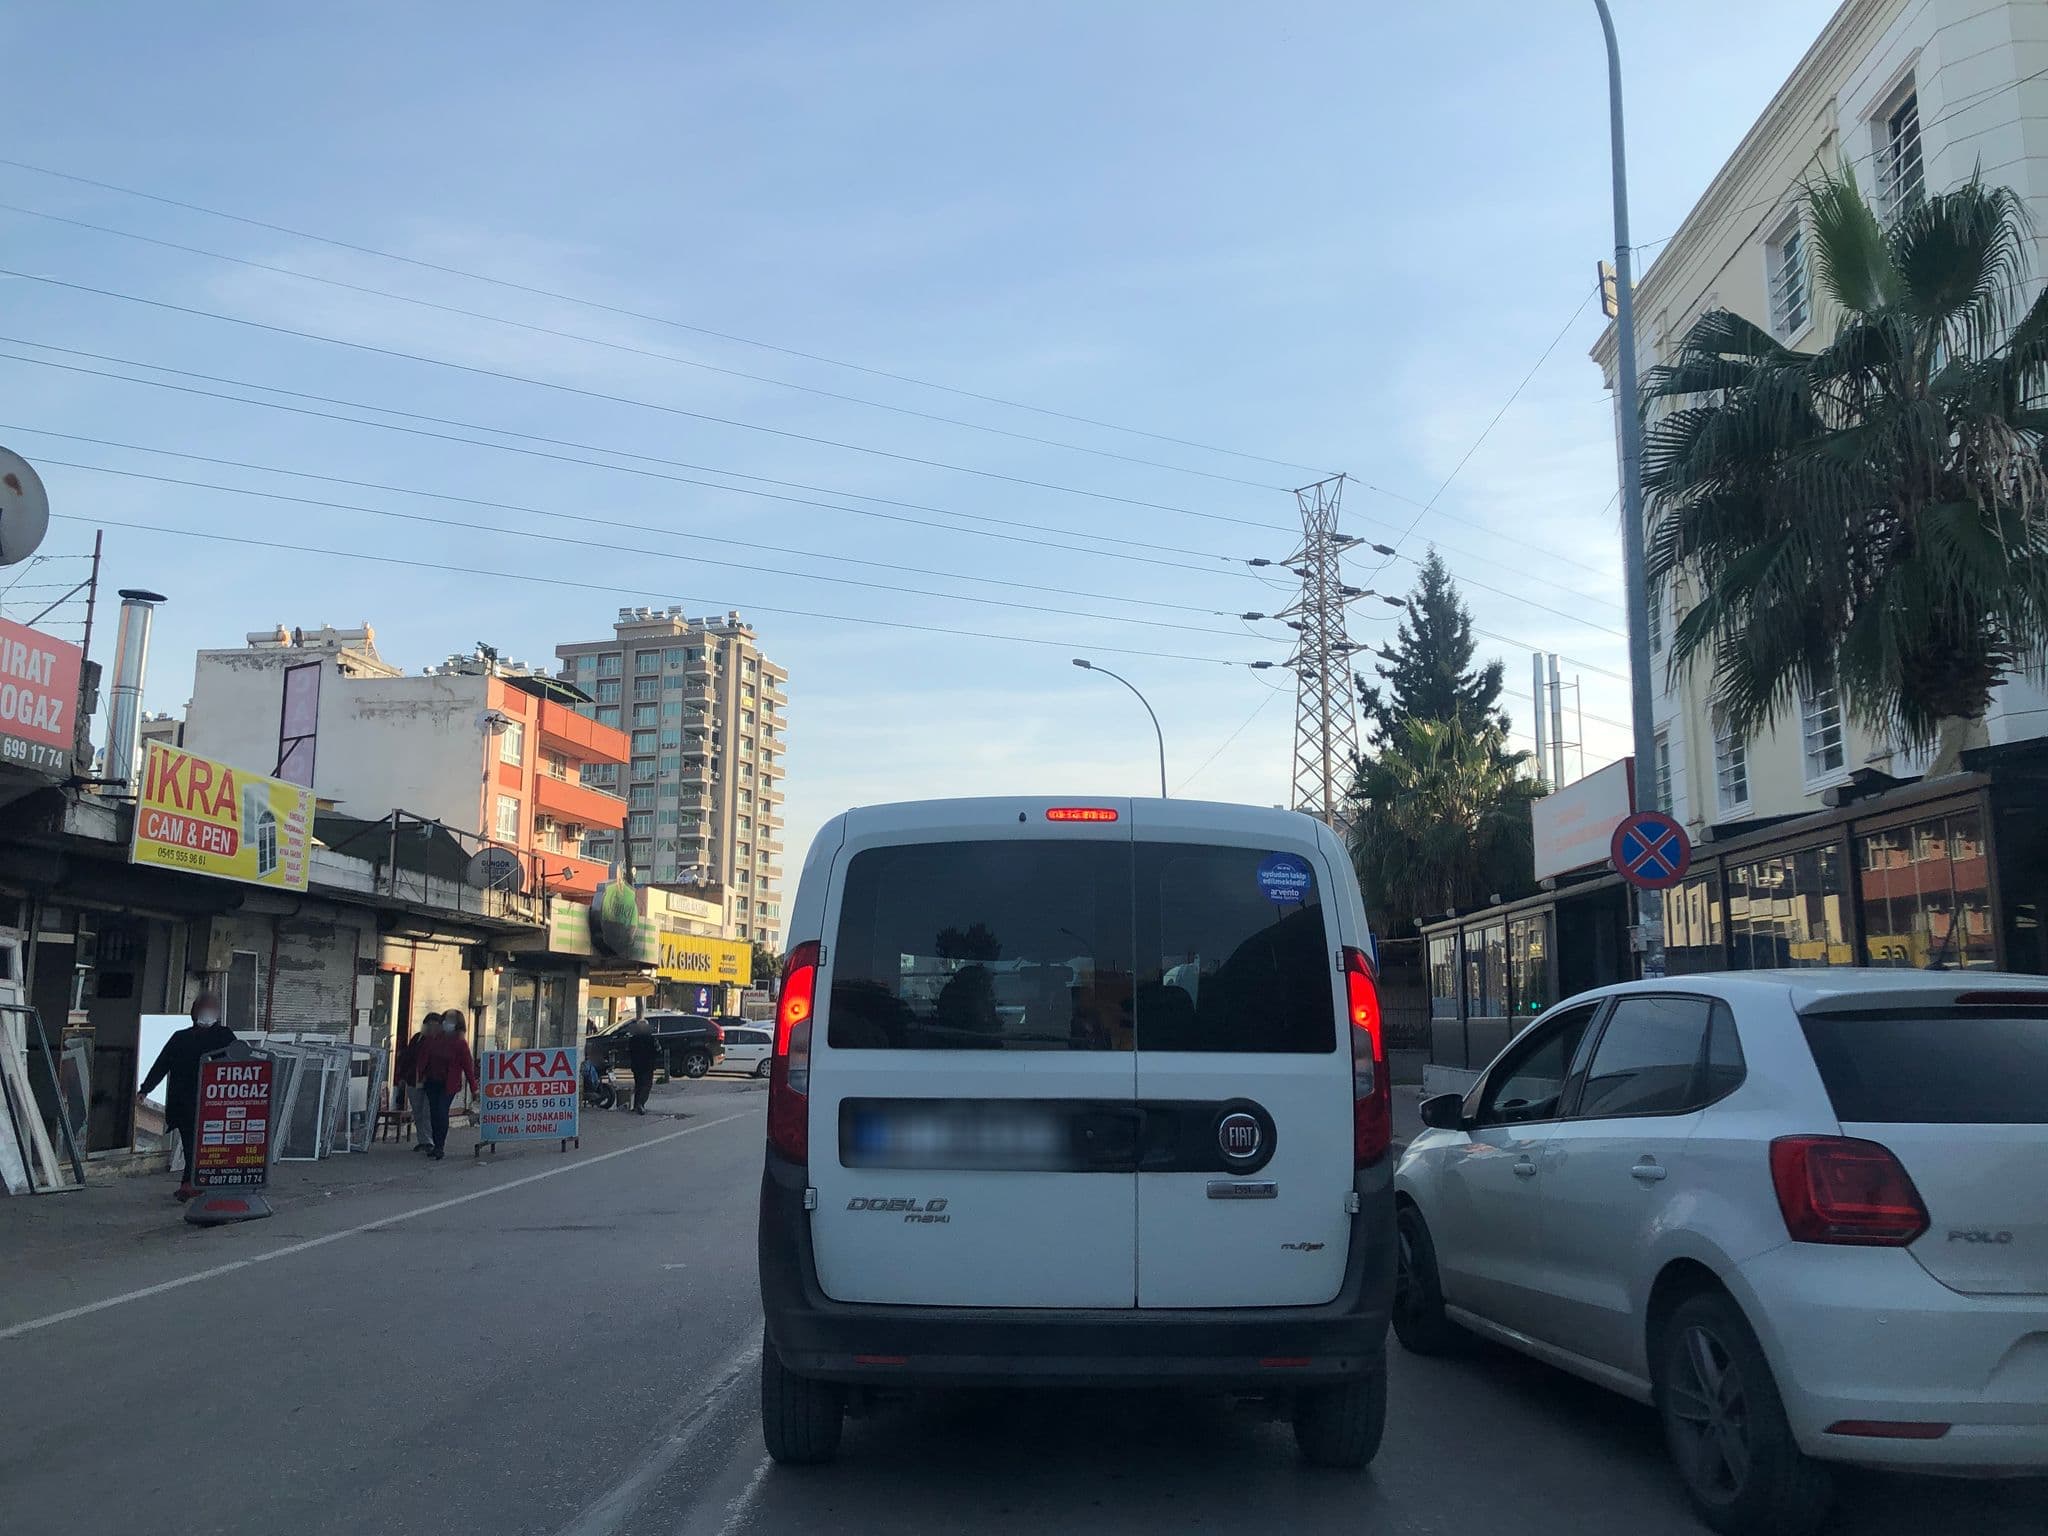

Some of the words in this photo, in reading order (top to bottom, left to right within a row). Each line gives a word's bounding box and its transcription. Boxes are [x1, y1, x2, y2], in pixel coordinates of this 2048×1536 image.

[0, 636, 56, 687] IRAT
[0, 682, 63, 734] OGAZ
[4, 737, 27, 760] 699
[31, 744, 45, 765] 17
[48, 749, 63, 769] 74
[147, 813, 184, 843] CAM
[187, 822, 197, 846] &
[201, 826, 231, 853] PEN
[217, 1066, 262, 1081] FIRAT
[206, 1083, 269, 1099] OTOGAZ
[493, 1083, 523, 1096] CAM
[527, 1083, 537, 1095] &
[541, 1082, 568, 1094] PEN
[486, 1100, 514, 1110] 0545
[518, 1099, 538, 1109] 955
[542, 1099, 555, 1107] 96
[560, 1098, 571, 1107] 61
[498, 1126, 519, 1135] AYNA
[1229, 1127, 1252, 1147] FIAT
[847, 1198, 948, 1212] DOBLO
[1948, 1231, 2014, 1244] POLO
